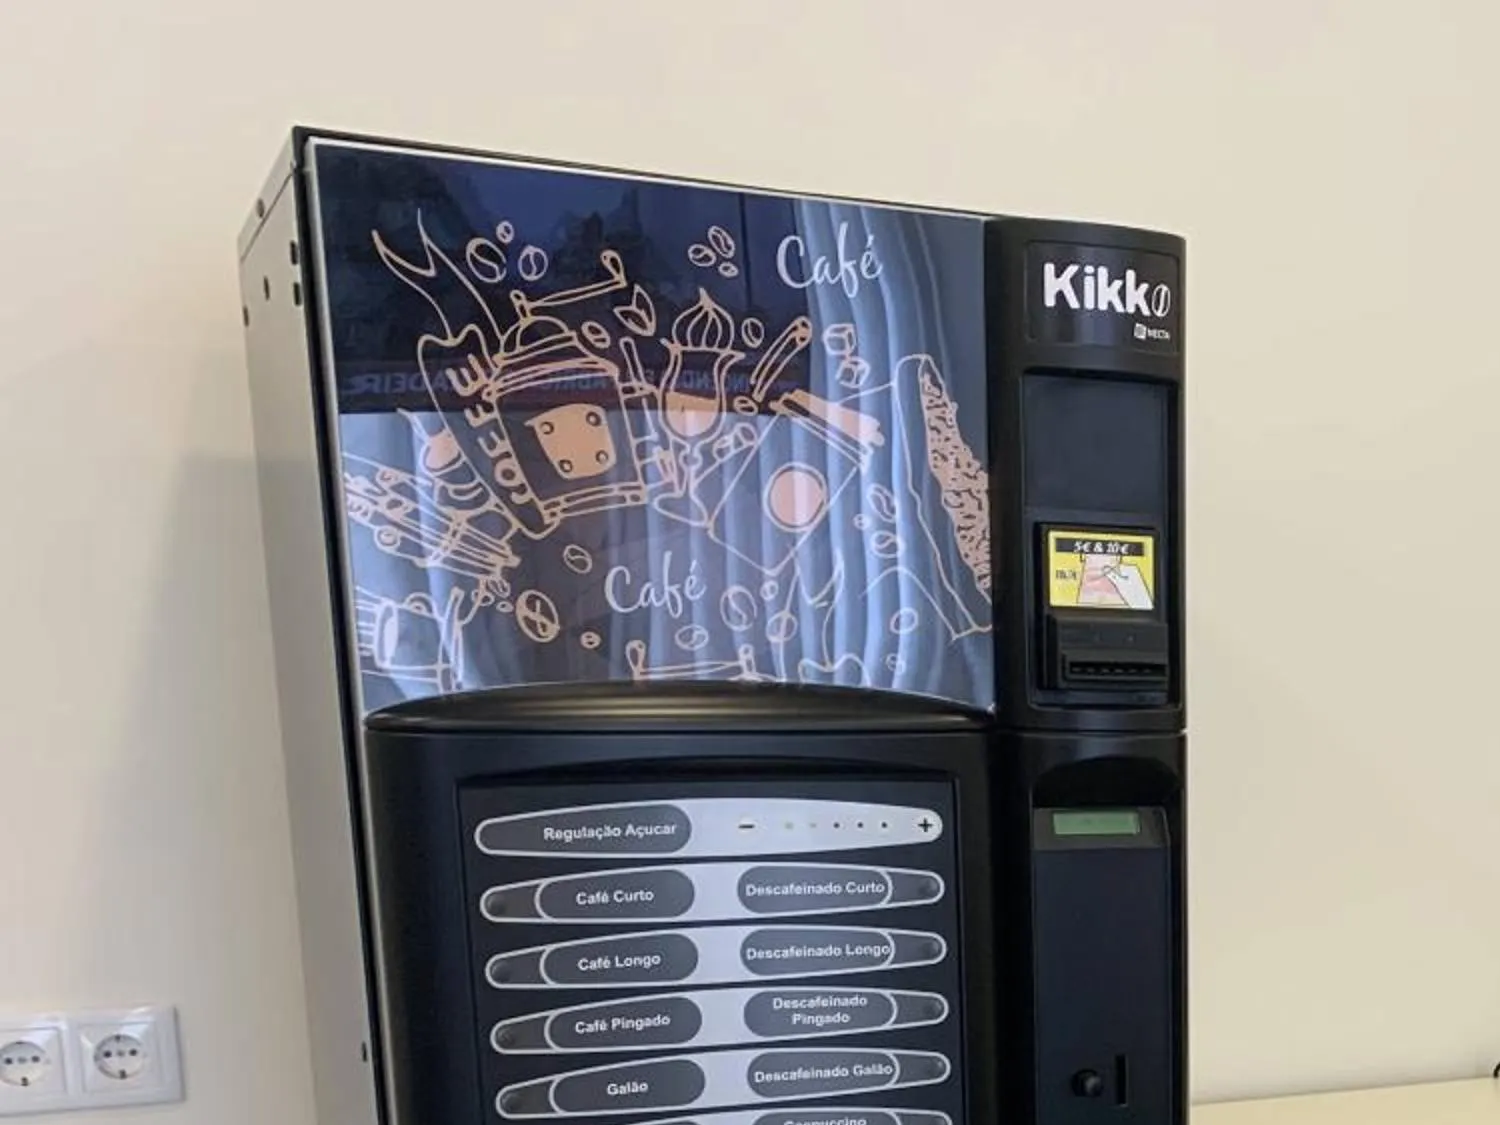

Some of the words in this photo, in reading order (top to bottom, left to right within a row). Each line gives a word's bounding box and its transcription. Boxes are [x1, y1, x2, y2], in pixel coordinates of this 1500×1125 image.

[777, 221, 883, 298] Café
[604, 550, 707, 618] Café
[544, 825, 622, 843] Regulação
[626, 823, 677, 838] Açucar
[576, 891, 609, 905] Café
[613, 889, 654, 903] Curto
[746, 882, 842, 897] Descafeinado
[846, 881, 886, 895] Curto
[746, 944, 842, 960] Descafeinado
[846, 943, 889, 959] Longo
[578, 955, 611, 970] Café
[615, 954, 661, 970] Longo
[773, 995, 867, 1010] Descafeinado
[575, 1018, 609, 1033] Café
[613, 1015, 670, 1032] Pingado
[792, 1011, 850, 1026] Pingado
[755, 1066, 849, 1082] Descafeinado
[853, 1063, 893, 1078] Galão
[607, 1081, 648, 1095] Galão
